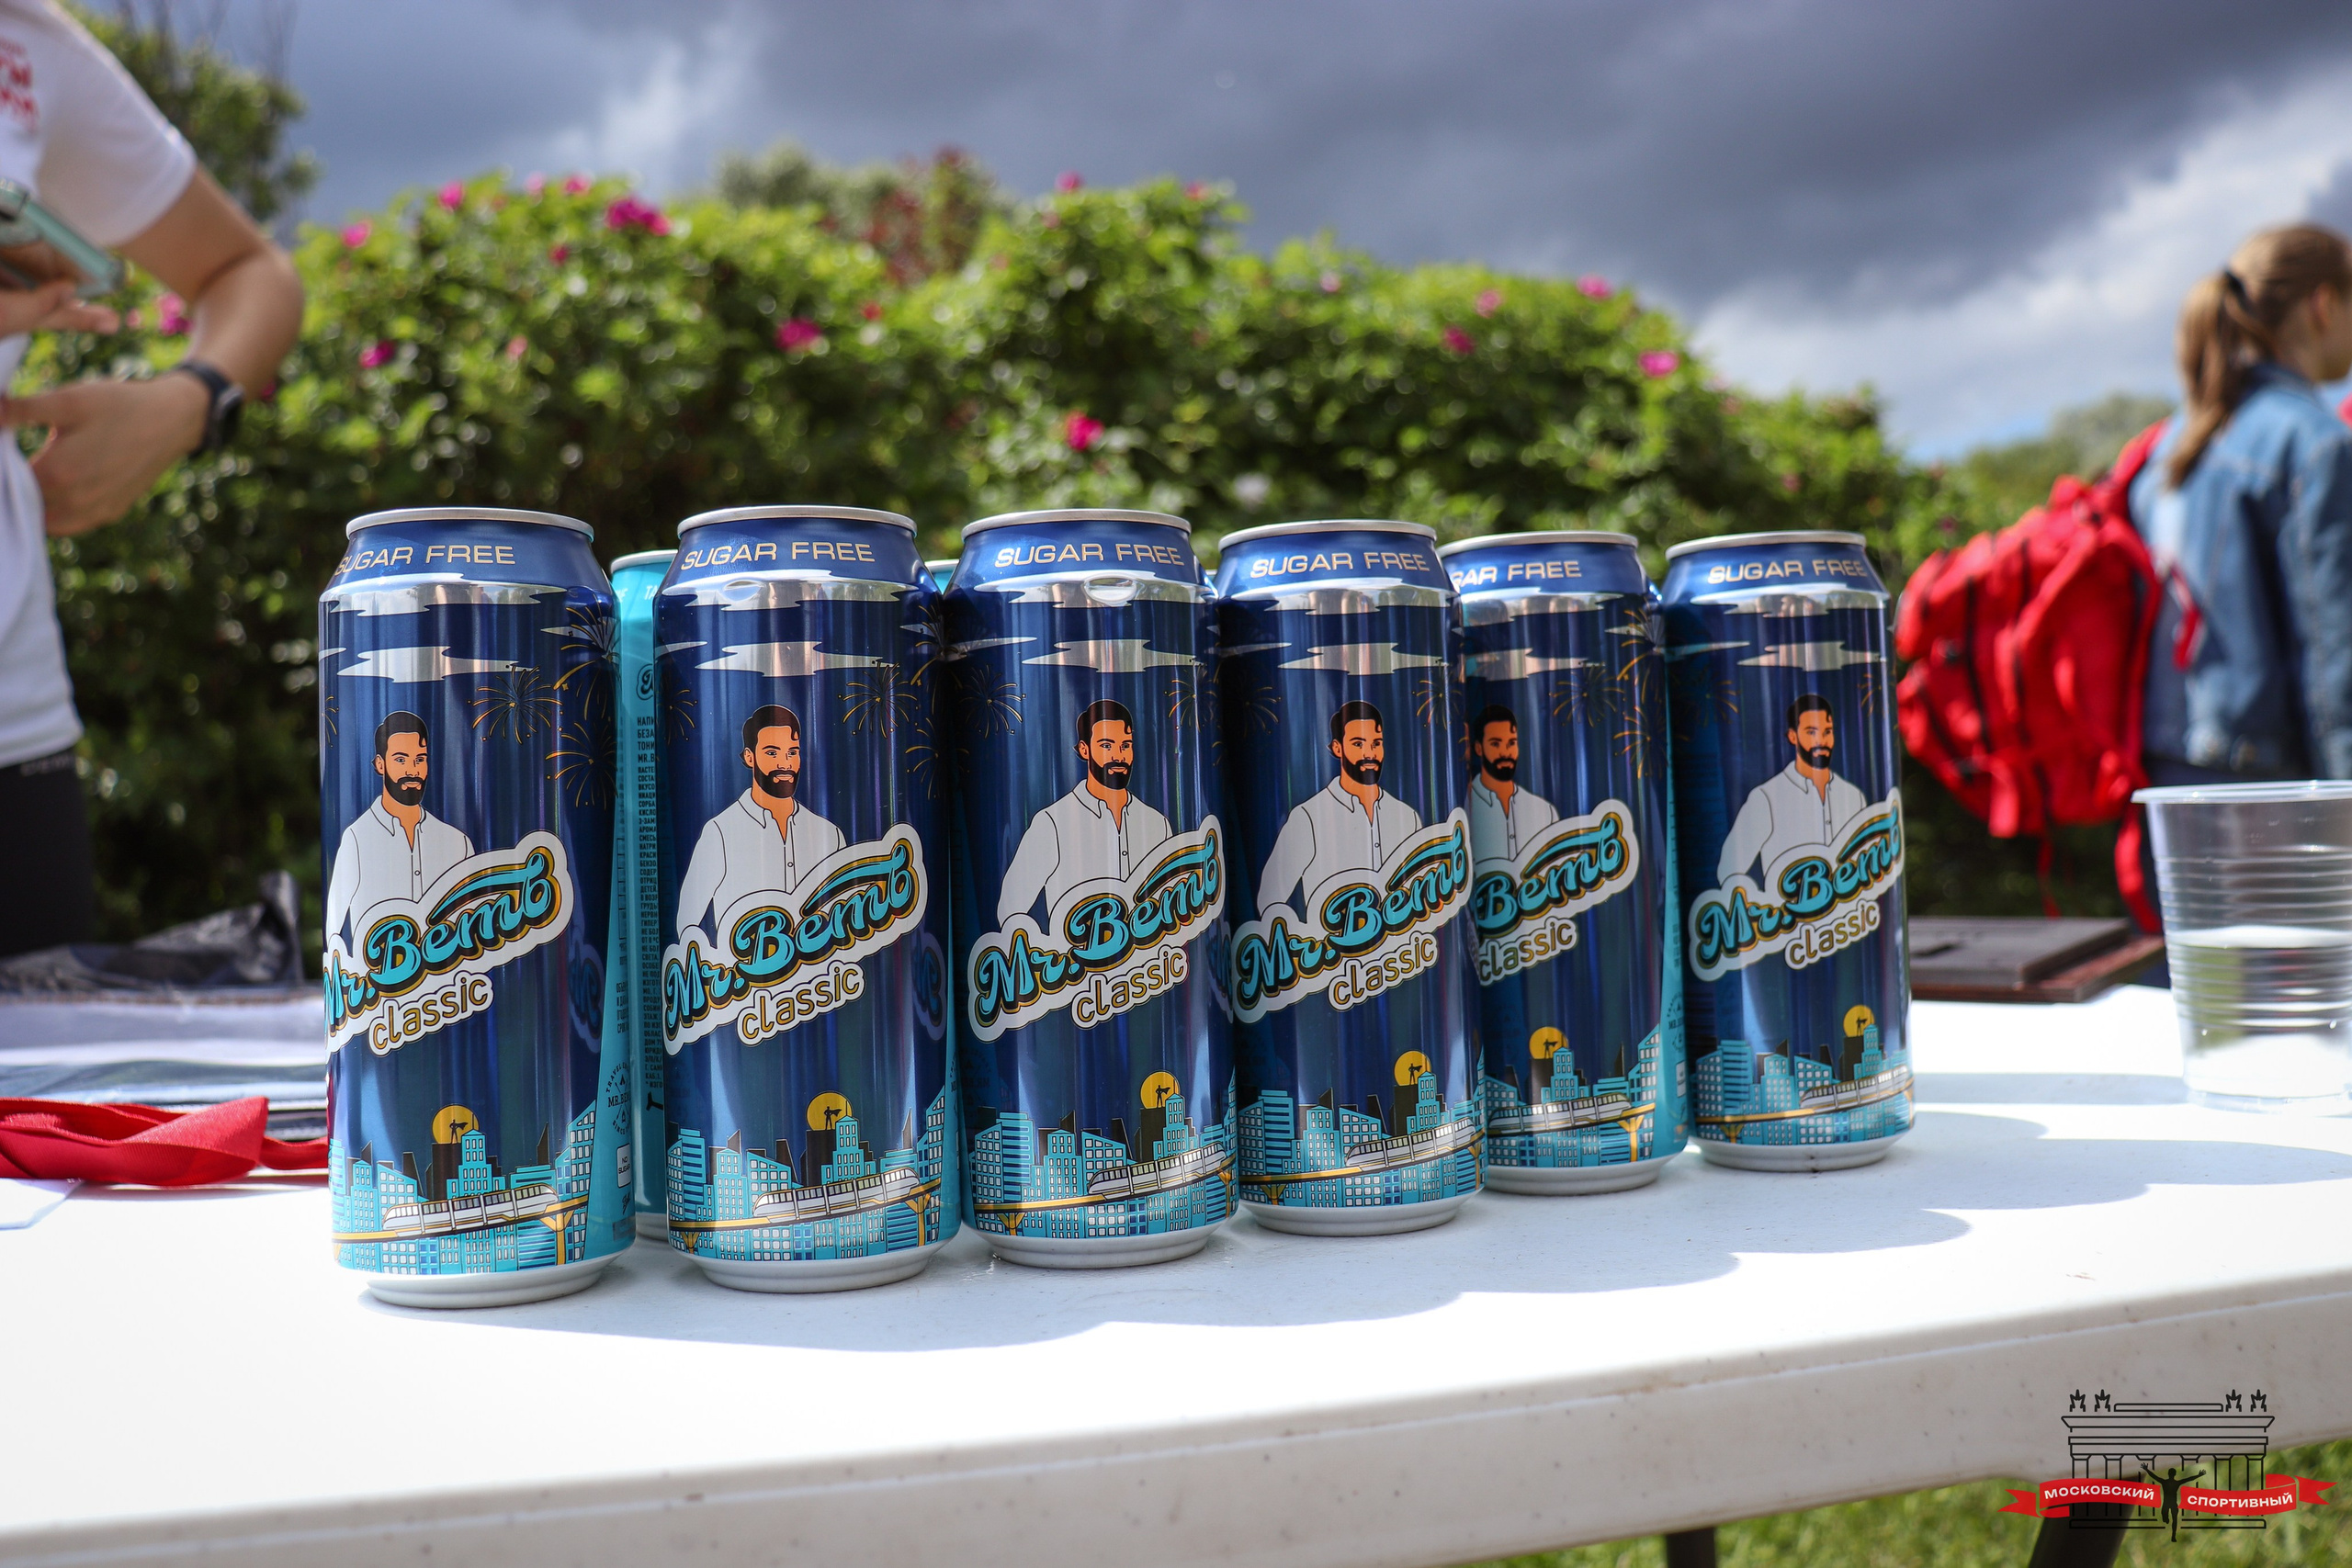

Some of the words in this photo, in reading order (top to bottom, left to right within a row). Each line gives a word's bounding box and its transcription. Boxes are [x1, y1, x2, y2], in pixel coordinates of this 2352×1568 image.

[334, 546, 413, 576] SUGAR
[425, 545, 515, 565] FREE
[681, 542, 777, 570] SUGAR
[791, 541, 876, 562] FREE
[994, 544, 1104, 568] SUGAR
[1114, 544, 1185, 566] FREE
[1250, 553, 1354, 578] SUGAR
[1363, 552, 1430, 571] FREE
[1450, 566, 1498, 588] GAR
[1507, 561, 1582, 581] FREE
[1707, 560, 1804, 584] SUGAR
[1812, 559, 1868, 577] FREE
[637, 728, 655, 739] БЕЗА
[638, 741, 655, 750] ТОНИ
[638, 754, 655, 763] MR.B
[640, 868, 657, 876] СОДЕР
[1789, 904, 1878, 964] classic
[1479, 921, 1574, 982] classic
[1332, 936, 1435, 1005] classic
[1075, 950, 1185, 1022] classic
[371, 976, 490, 1051] classic
[741, 965, 861, 1040] classic
[607, 1091, 631, 1108] MR.BE
